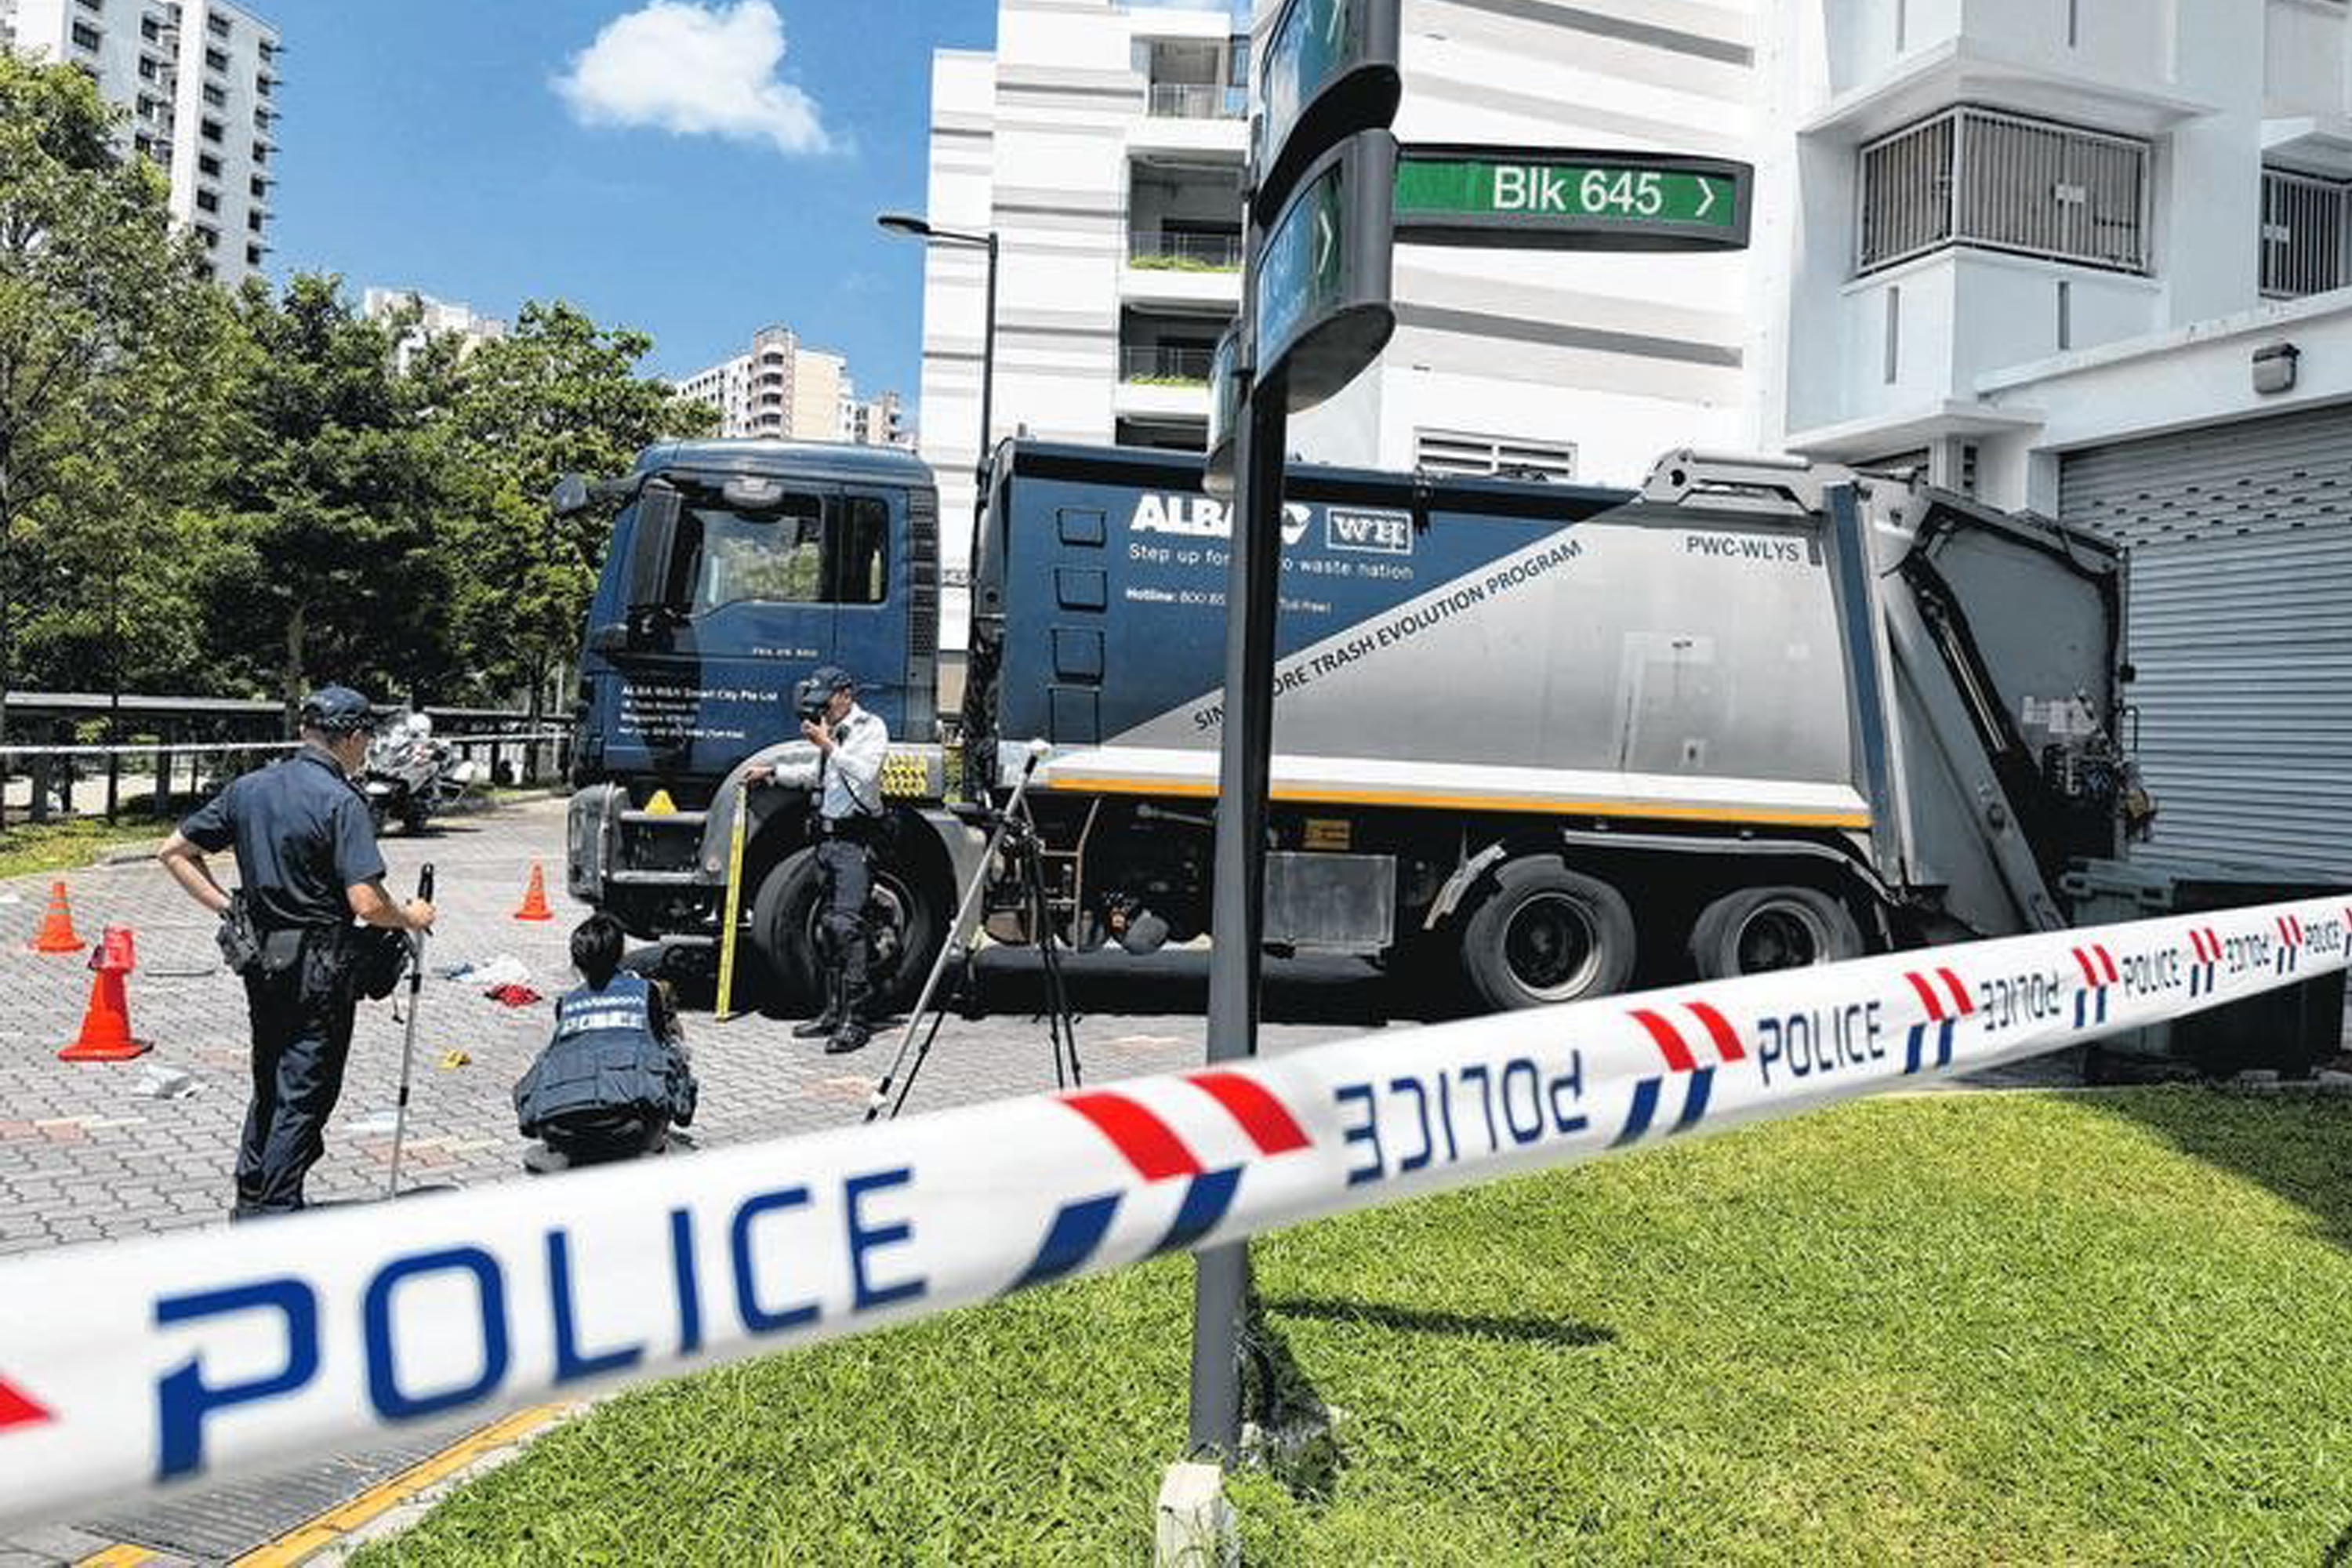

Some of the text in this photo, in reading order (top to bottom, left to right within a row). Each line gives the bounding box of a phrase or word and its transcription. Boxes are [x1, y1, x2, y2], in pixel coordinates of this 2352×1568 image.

[1494, 165, 1663, 216] Blk 645
[1129, 543, 1170, 563] Step
[1178, 551, 1200, 565] up
[1300, 559, 1350, 576] waste
[1357, 563, 1414, 580] nation
[1686, 536, 1800, 562] PWC-WLYS
[1126, 589, 1177, 603] Hotline:
[1310, 637, 1376, 677] TRASH
[1377, 585, 1486, 648] EVOLUTION
[1486, 539, 1583, 595] PROGRAM
[717, 689, 738, 702] City
[741, 690, 757, 700] Pte
[760, 691, 779, 701] Ltd
[2305, 920, 2340, 954] POLICE
[2122, 949, 2181, 996] POLICE
[1980, 971, 2060, 1030] POLICE
[1758, 1002, 1885, 1085] POLICE
[1335, 1050, 1588, 1186] POLICE
[153, 1167, 931, 1483] POLICE
